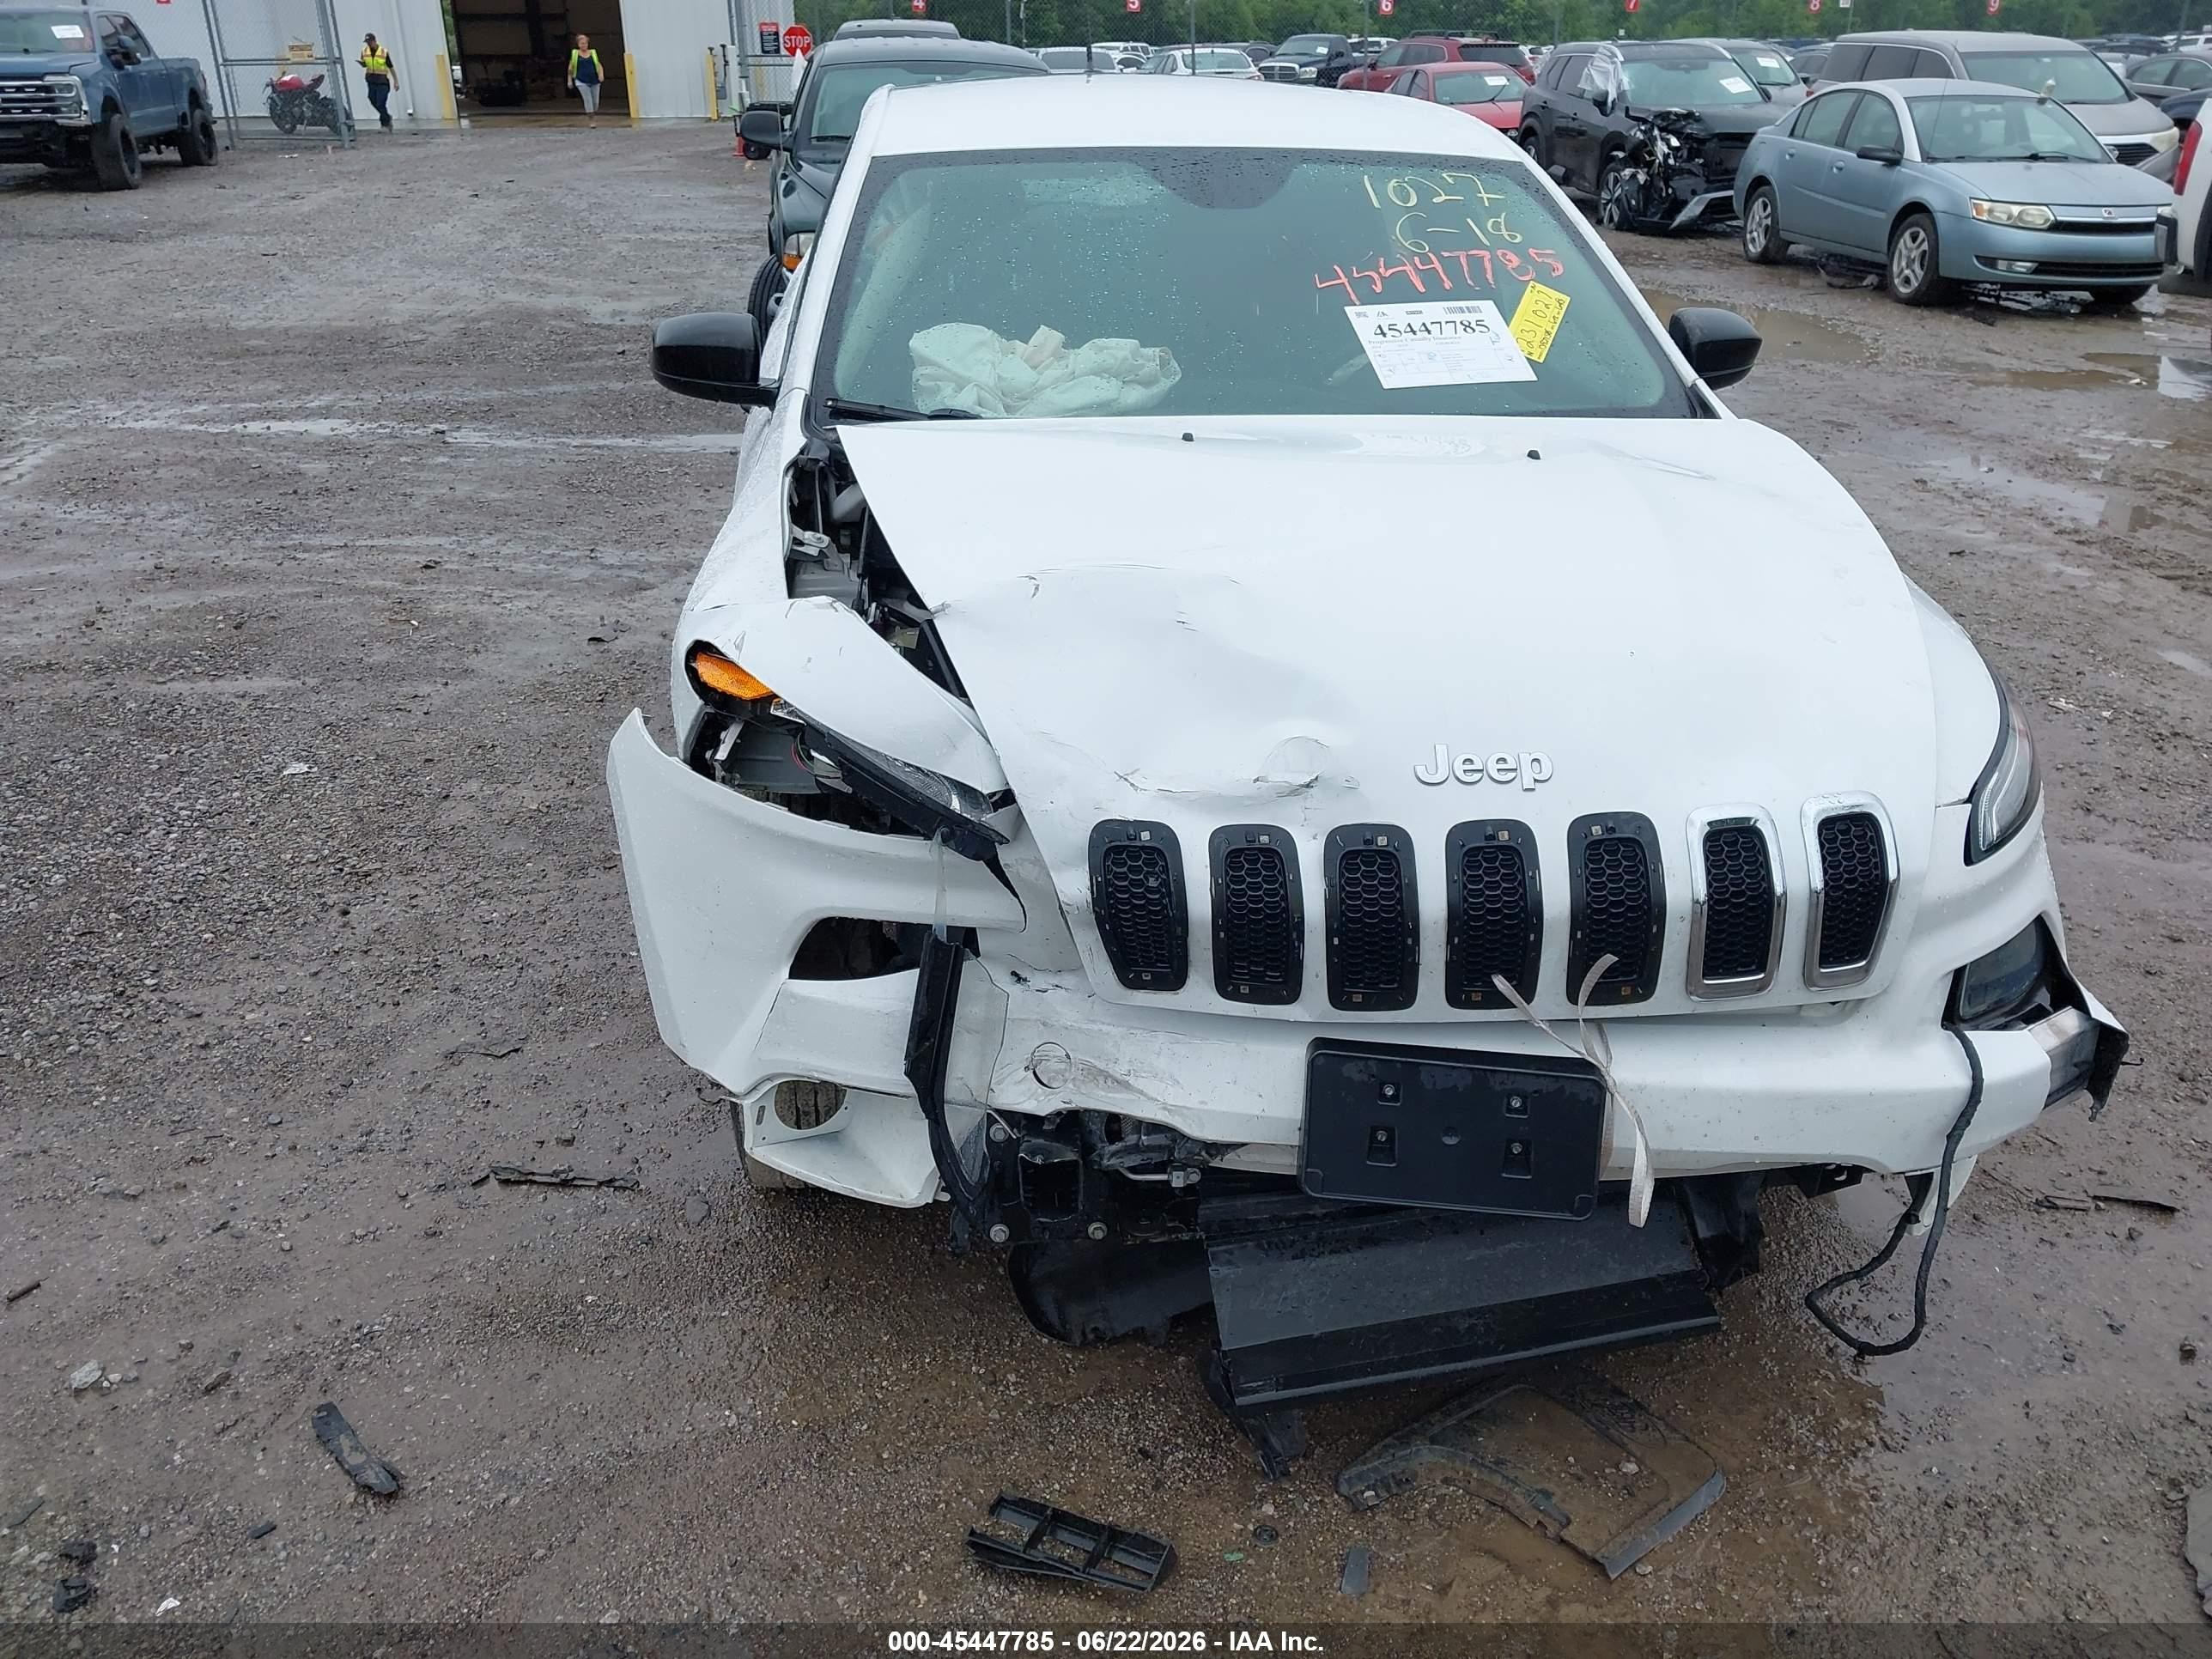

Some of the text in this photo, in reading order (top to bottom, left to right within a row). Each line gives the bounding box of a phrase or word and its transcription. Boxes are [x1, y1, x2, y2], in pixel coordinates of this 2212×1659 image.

[1382, 0, 1392, 11] 6
[784, 35, 811, 48] STOP
[1364, 173, 1505, 208] 1027
[1395, 212, 1522, 253] 6-18
[1314, 248, 1564, 305] 45447785
[1373, 319, 1491, 338] 45447785
[1414, 744, 1553, 791] Jeep
